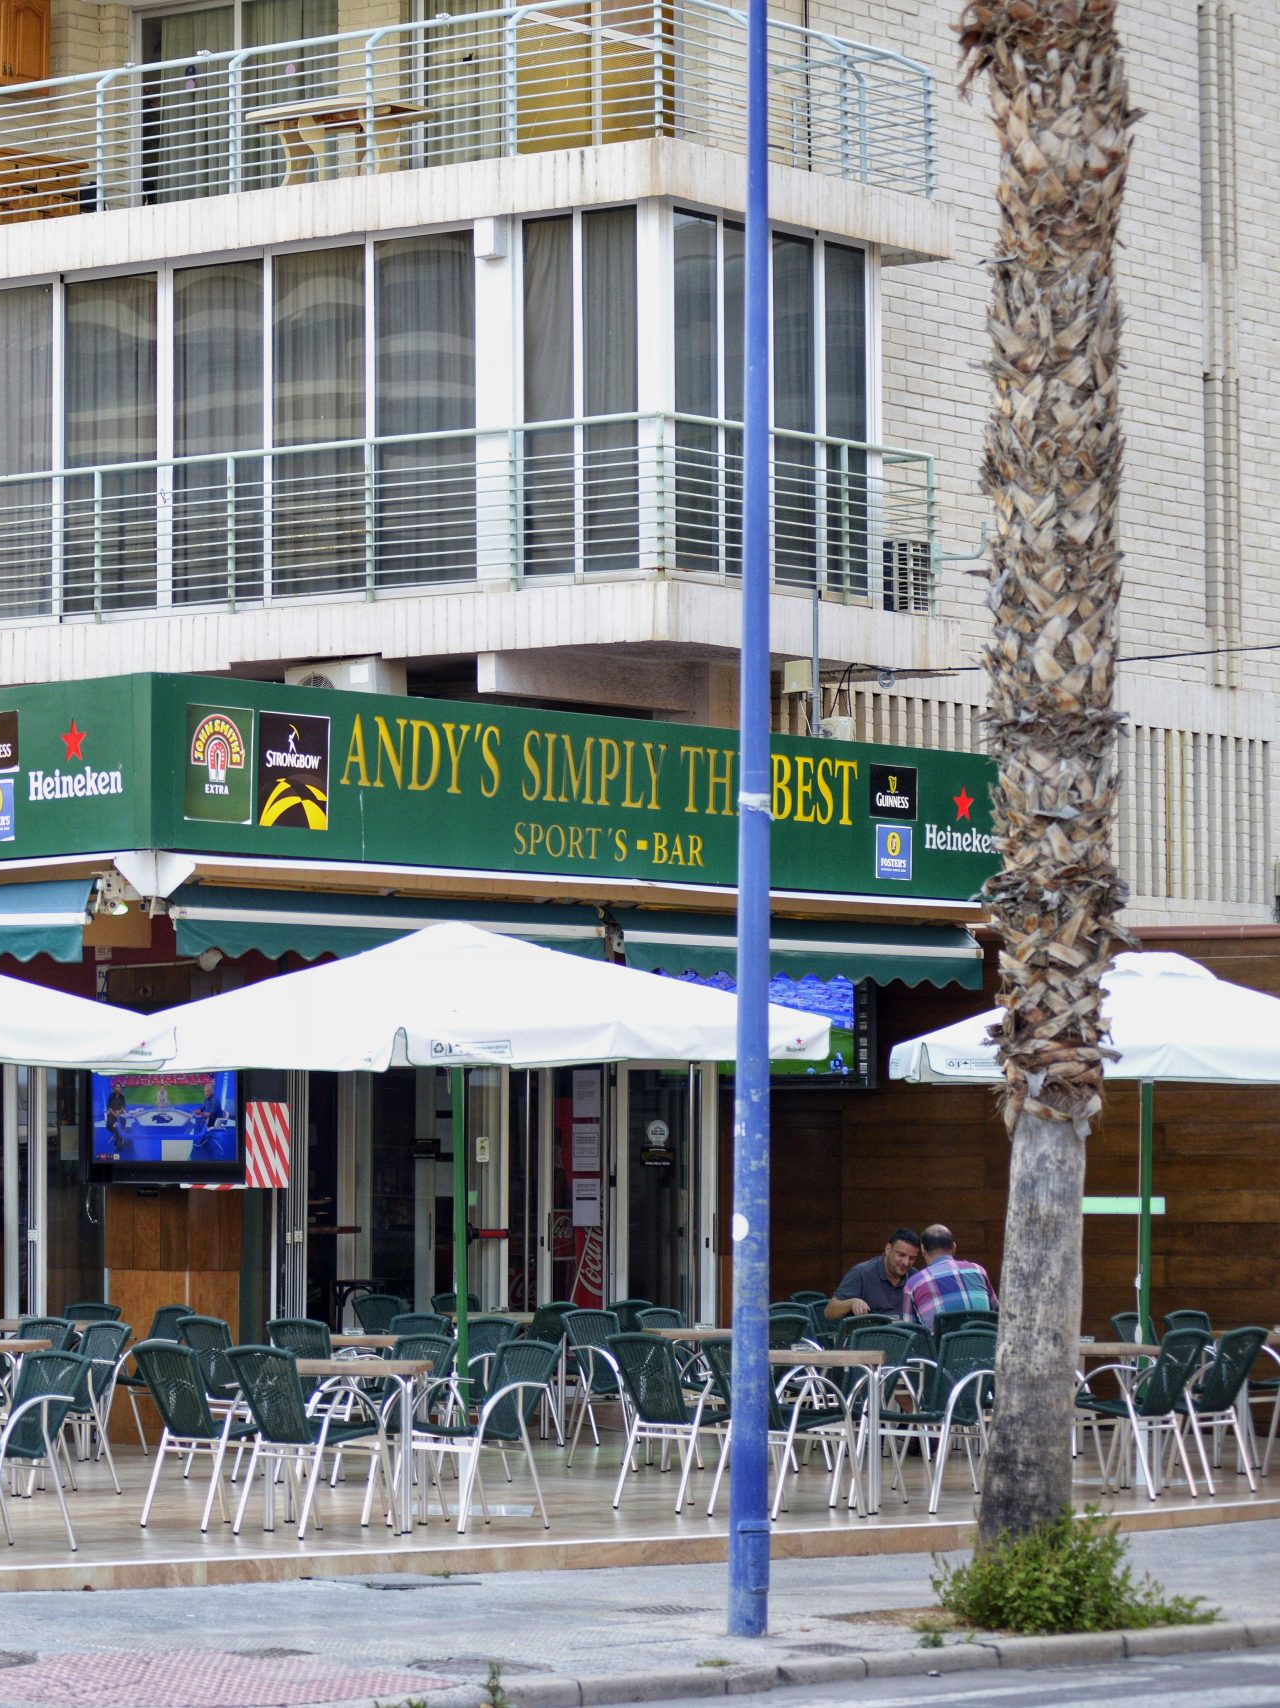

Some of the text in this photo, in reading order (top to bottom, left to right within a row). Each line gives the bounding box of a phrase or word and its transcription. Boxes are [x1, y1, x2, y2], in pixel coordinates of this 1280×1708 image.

[266, 750, 320, 770] STRONGBOW
[340, 712, 858, 826] ANDY'S SIMPLY TH BEST
[28, 766, 123, 801] Heineken
[204, 783, 229, 795] EXTRA
[876, 792, 909, 809] GUINNESS
[514, 821, 704, 867] SPORT'S BAR
